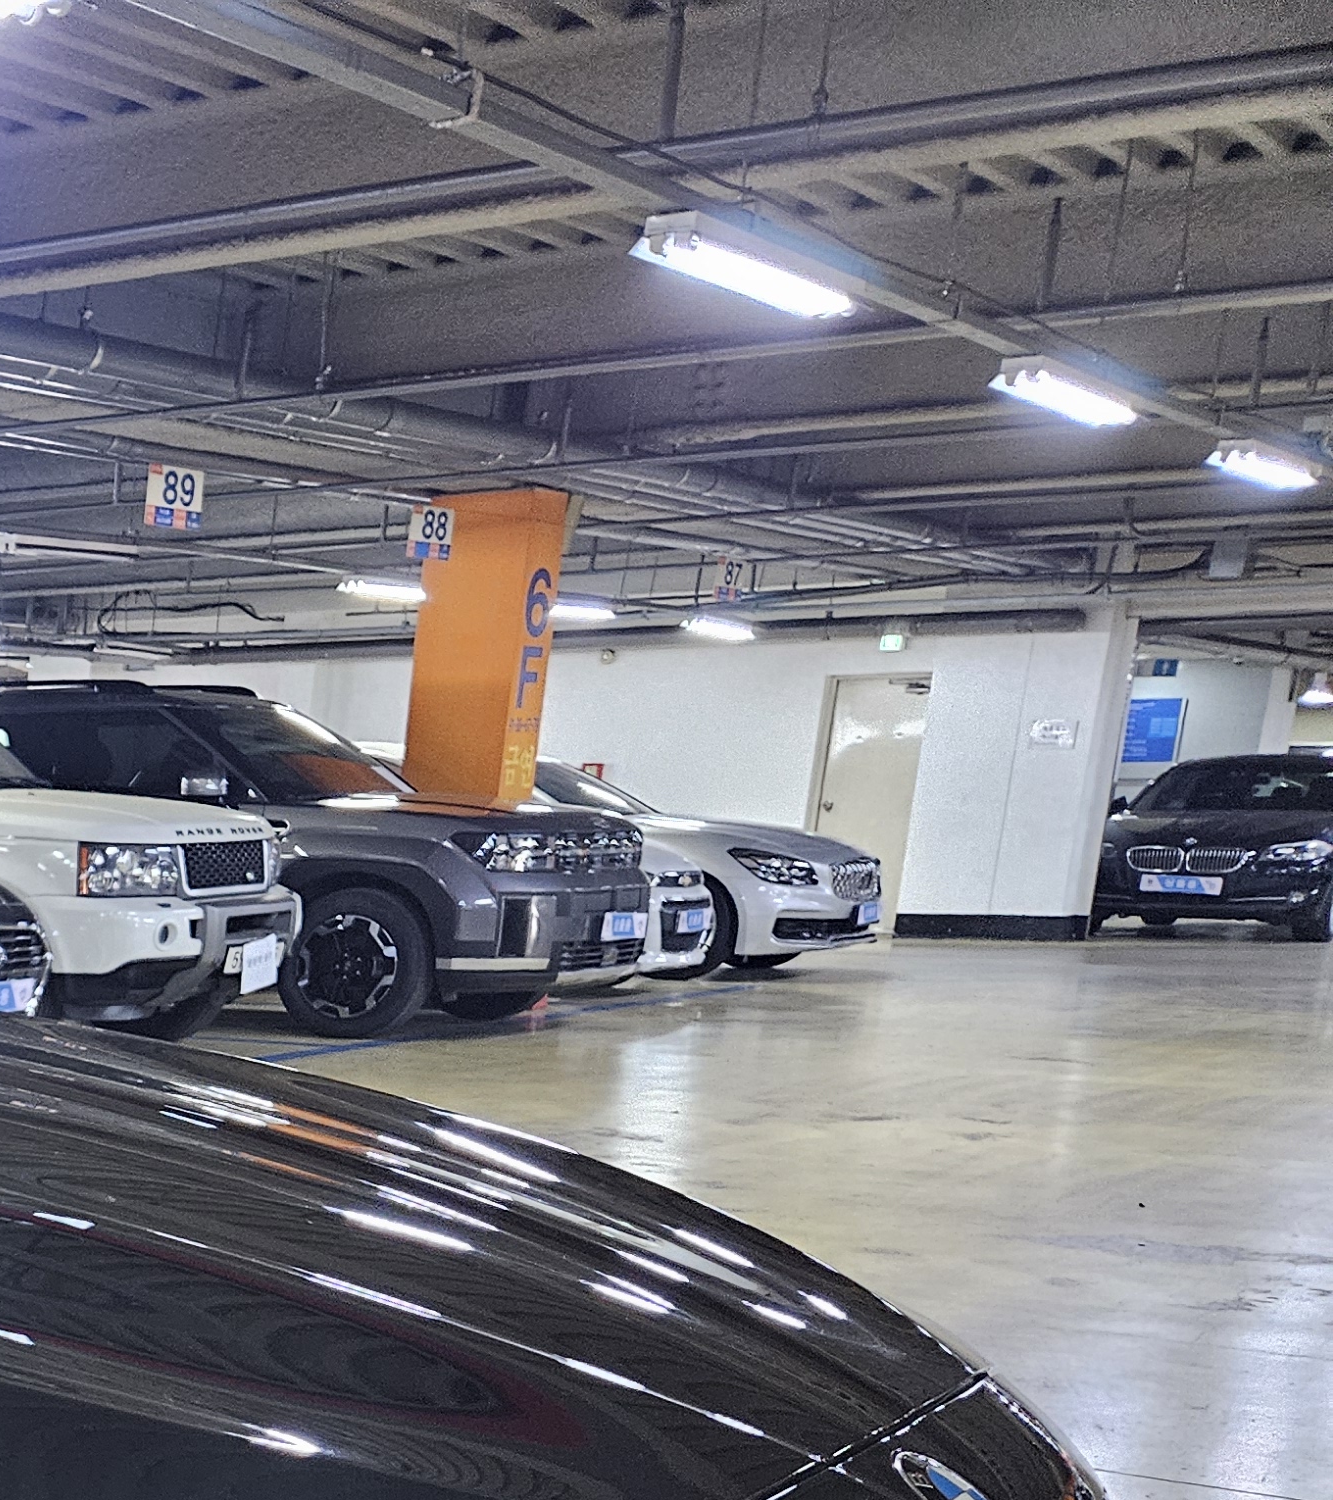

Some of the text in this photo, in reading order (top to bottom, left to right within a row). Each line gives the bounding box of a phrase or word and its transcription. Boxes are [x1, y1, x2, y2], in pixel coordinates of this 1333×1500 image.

[163, 471, 195, 507] 89
[422, 510, 448, 540] 88
[724, 561, 742, 586] 87
[516, 568, 552, 708] 6F
[175, 826, 264, 837] RANGE ROVER
